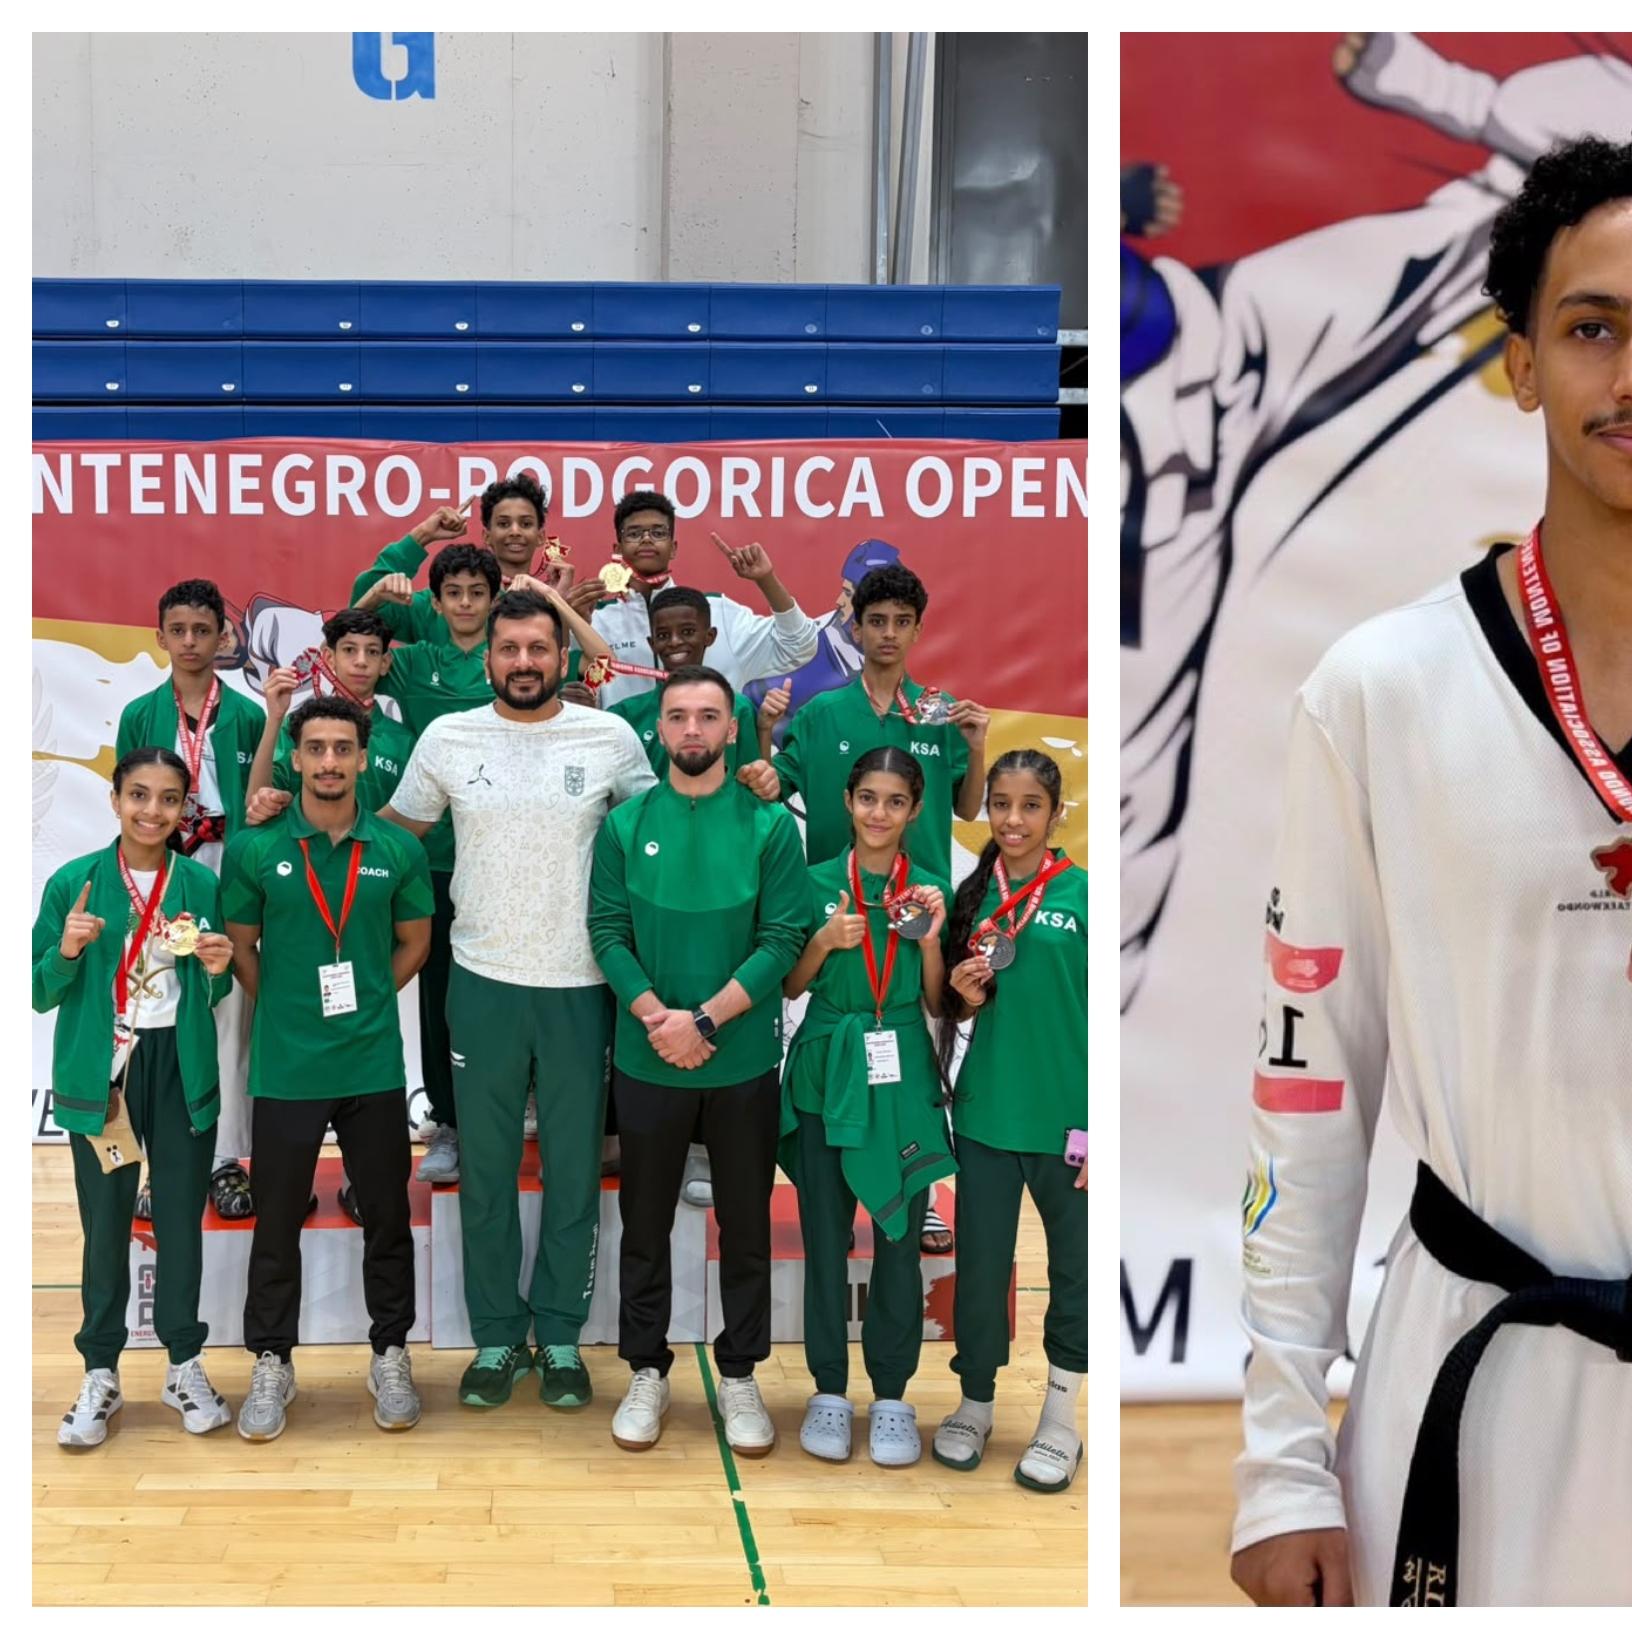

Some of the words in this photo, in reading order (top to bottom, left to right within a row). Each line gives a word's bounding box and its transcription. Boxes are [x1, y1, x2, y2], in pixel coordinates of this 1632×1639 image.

[905, 455, 1088, 518] OPEN
[910, 741, 941, 757] KSA
[374, 755, 398, 776] KSA
[1035, 909, 1077, 933] KSA
